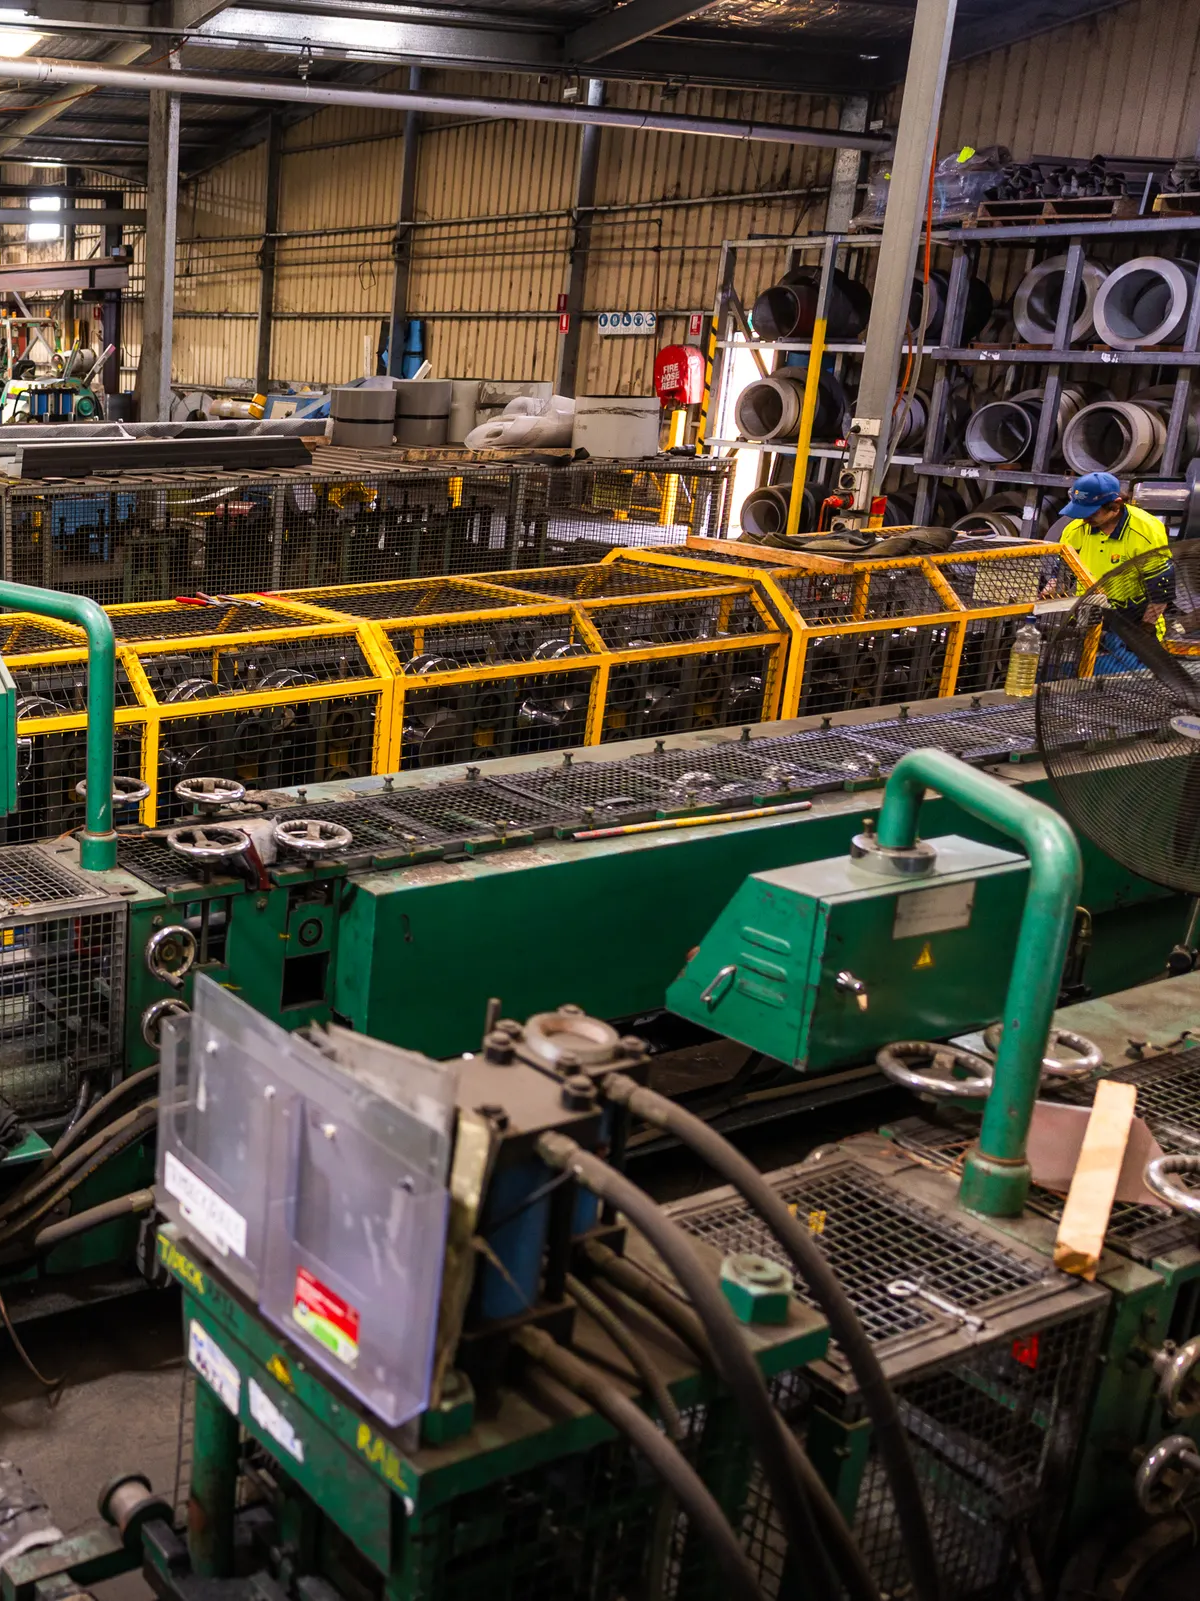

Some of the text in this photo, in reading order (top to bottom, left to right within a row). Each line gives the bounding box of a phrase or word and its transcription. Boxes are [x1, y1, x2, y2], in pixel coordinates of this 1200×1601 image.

[663, 363, 679, 374] FIRE
[661, 371, 680, 383] HOSE
[661, 380, 679, 390] REEL
